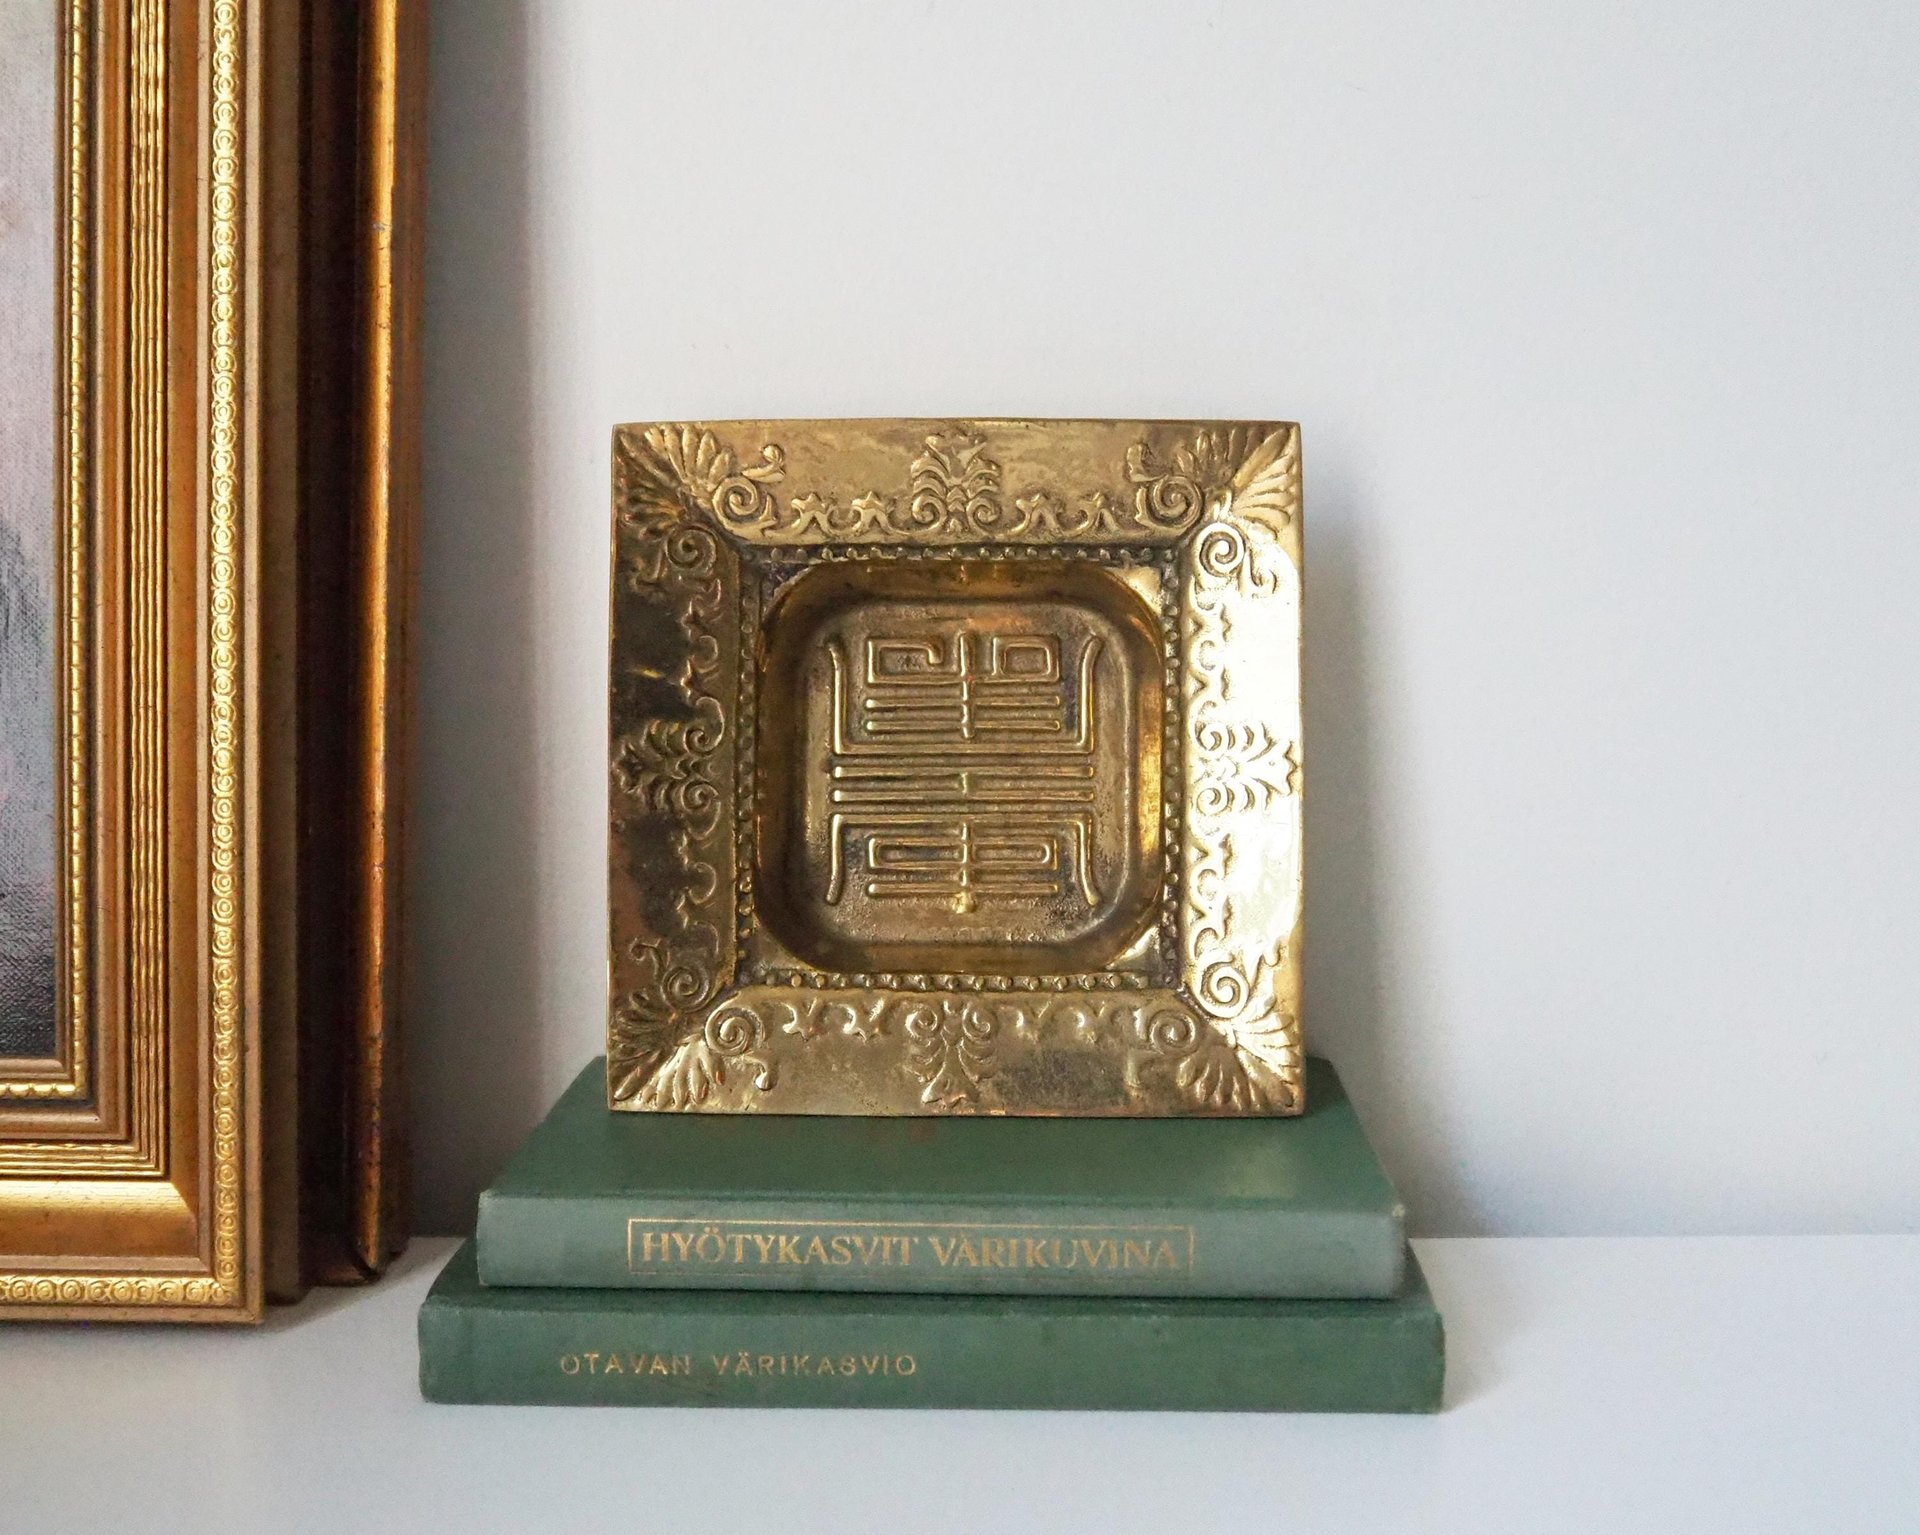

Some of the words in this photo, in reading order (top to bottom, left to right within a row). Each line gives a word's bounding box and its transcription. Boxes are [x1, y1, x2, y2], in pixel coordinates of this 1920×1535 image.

[642, 1226, 919, 1266] HYÖTYKASVIT
[560, 1352, 690, 1375] OTAVAN
[712, 1352, 916, 1376] VÄRIKASVIO
